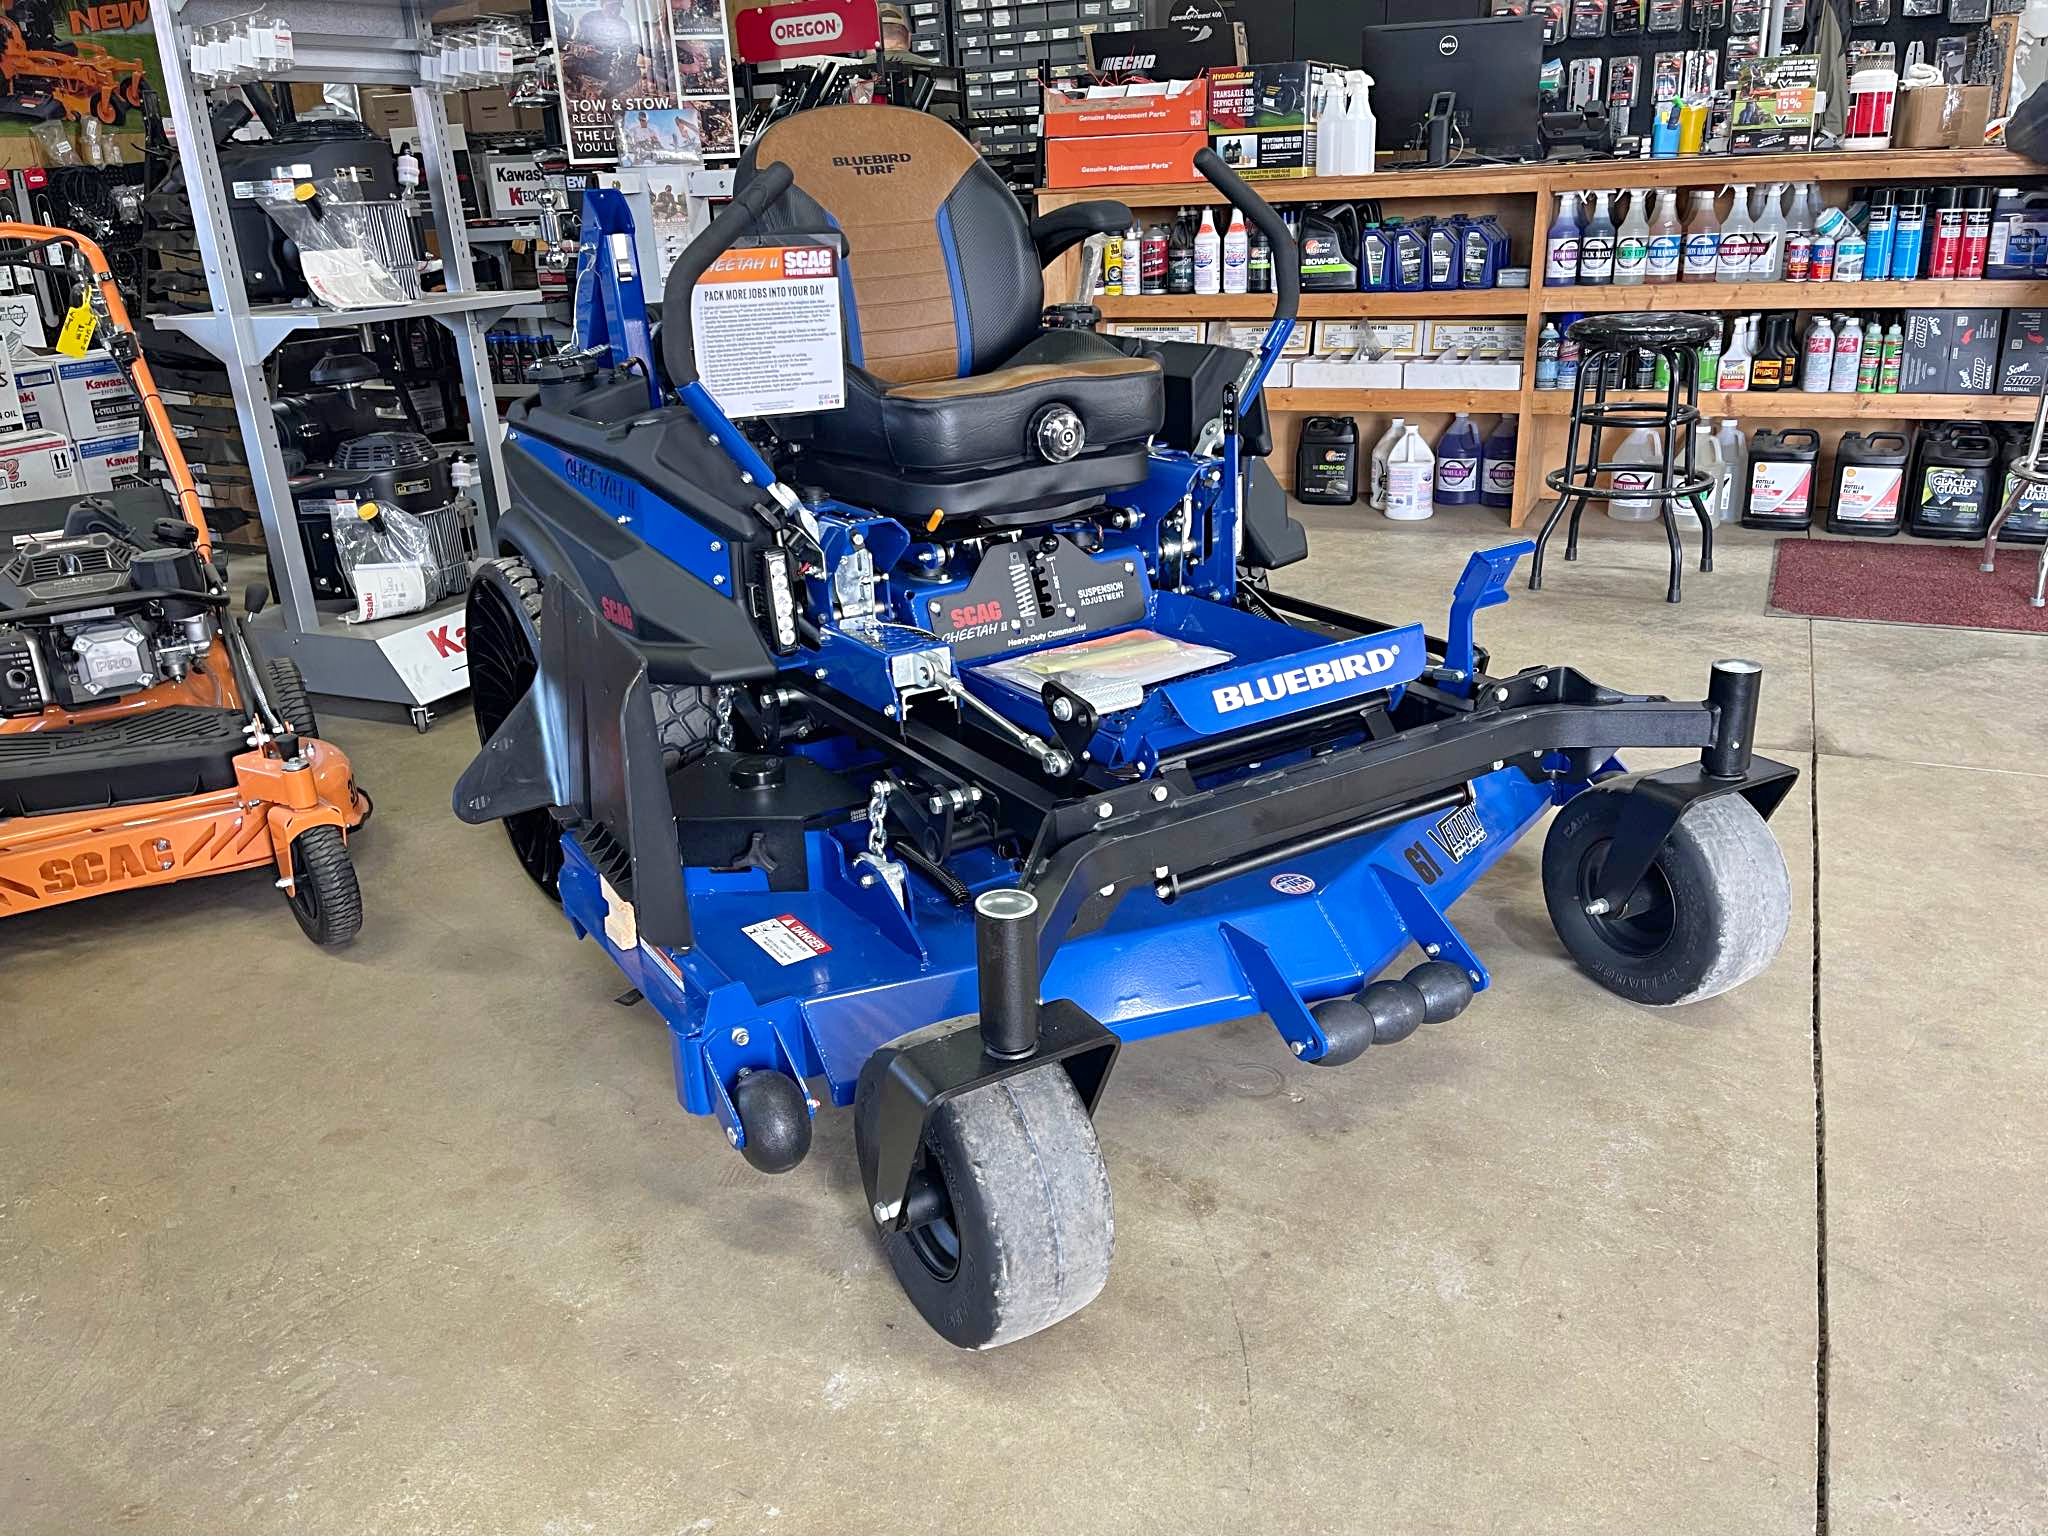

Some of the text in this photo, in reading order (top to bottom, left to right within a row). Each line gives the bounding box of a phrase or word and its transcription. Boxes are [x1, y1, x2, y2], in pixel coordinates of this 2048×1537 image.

[775, 18, 836, 40] OREGON
[1113, 54, 1156, 70] ECHO
[1213, 90, 1243, 98] TRANSAXLE
[572, 97, 672, 112] TOW & STOW.
[1213, 99, 1234, 107] SERVICE
[1235, 98, 1243, 106] KIT
[1776, 98, 1802, 110] 15%
[1105, 112, 1148, 121] Replacement
[575, 130, 600, 142] THE
[576, 142, 616, 153] YOU'LL
[832, 153, 911, 167] BLUEBIRD
[1108, 164, 1150, 172] Replacement
[852, 164, 896, 176] TURF
[784, 250, 831, 268] SCAG
[1305, 257, 1340, 265] 80W-90
[1582, 250, 1595, 258] LACK
[704, 284, 824, 302] PACK MORE JOBS INTO YOUR DAY
[1908, 316, 1916, 341] ORIGINAL
[1914, 316, 1928, 348] SHOP
[1928, 316, 1941, 336] Scott
[1972, 357, 1986, 389] SHOP
[2006, 362, 2030, 375] Scott
[1984, 364, 1993, 390] ORIGINAL
[2003, 375, 2041, 386] SHOP
[4, 410, 19, 419] OIL
[94, 406, 115, 417] 4-CYCLE
[565, 458, 624, 504] CHEETAH
[1934, 477, 1977, 488] GLACIER
[1937, 485, 1973, 496] GUARD
[1077, 581, 1124, 599] SUSPENSION
[1080, 590, 1125, 606] ADJUSTMENT
[602, 596, 635, 631] SCAG
[950, 601, 1003, 629] SCAG
[942, 624, 998, 644] CHEETAH
[1007, 623, 1087, 648] Heavy-Duty Commercial
[95, 656, 134, 672] PRO
[1427, 801, 1482, 864] VELOCITY
[39, 836, 175, 894] SCAG
[1404, 841, 1443, 885] 61
[791, 925, 825, 951] DANGER
